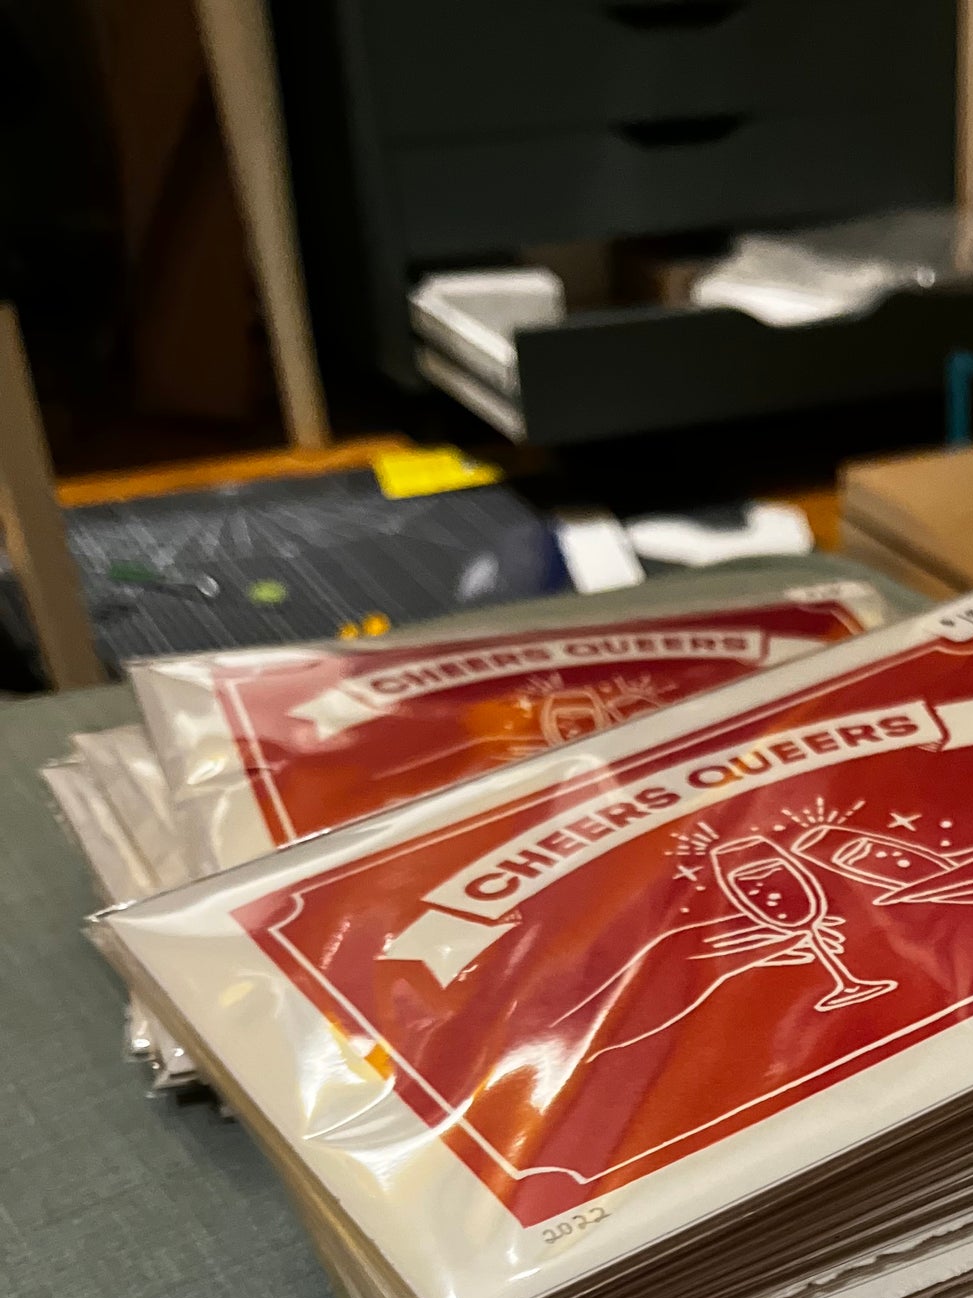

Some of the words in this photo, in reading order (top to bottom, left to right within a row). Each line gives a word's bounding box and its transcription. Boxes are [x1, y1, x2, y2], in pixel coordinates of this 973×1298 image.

[370, 647, 552, 694] CHEERS
[563, 635, 750, 658] QUEERS
[463, 785, 682, 902] CHEERS
[687, 714, 919, 790] QUEERS
[542, 1206, 612, 1244] 2022
